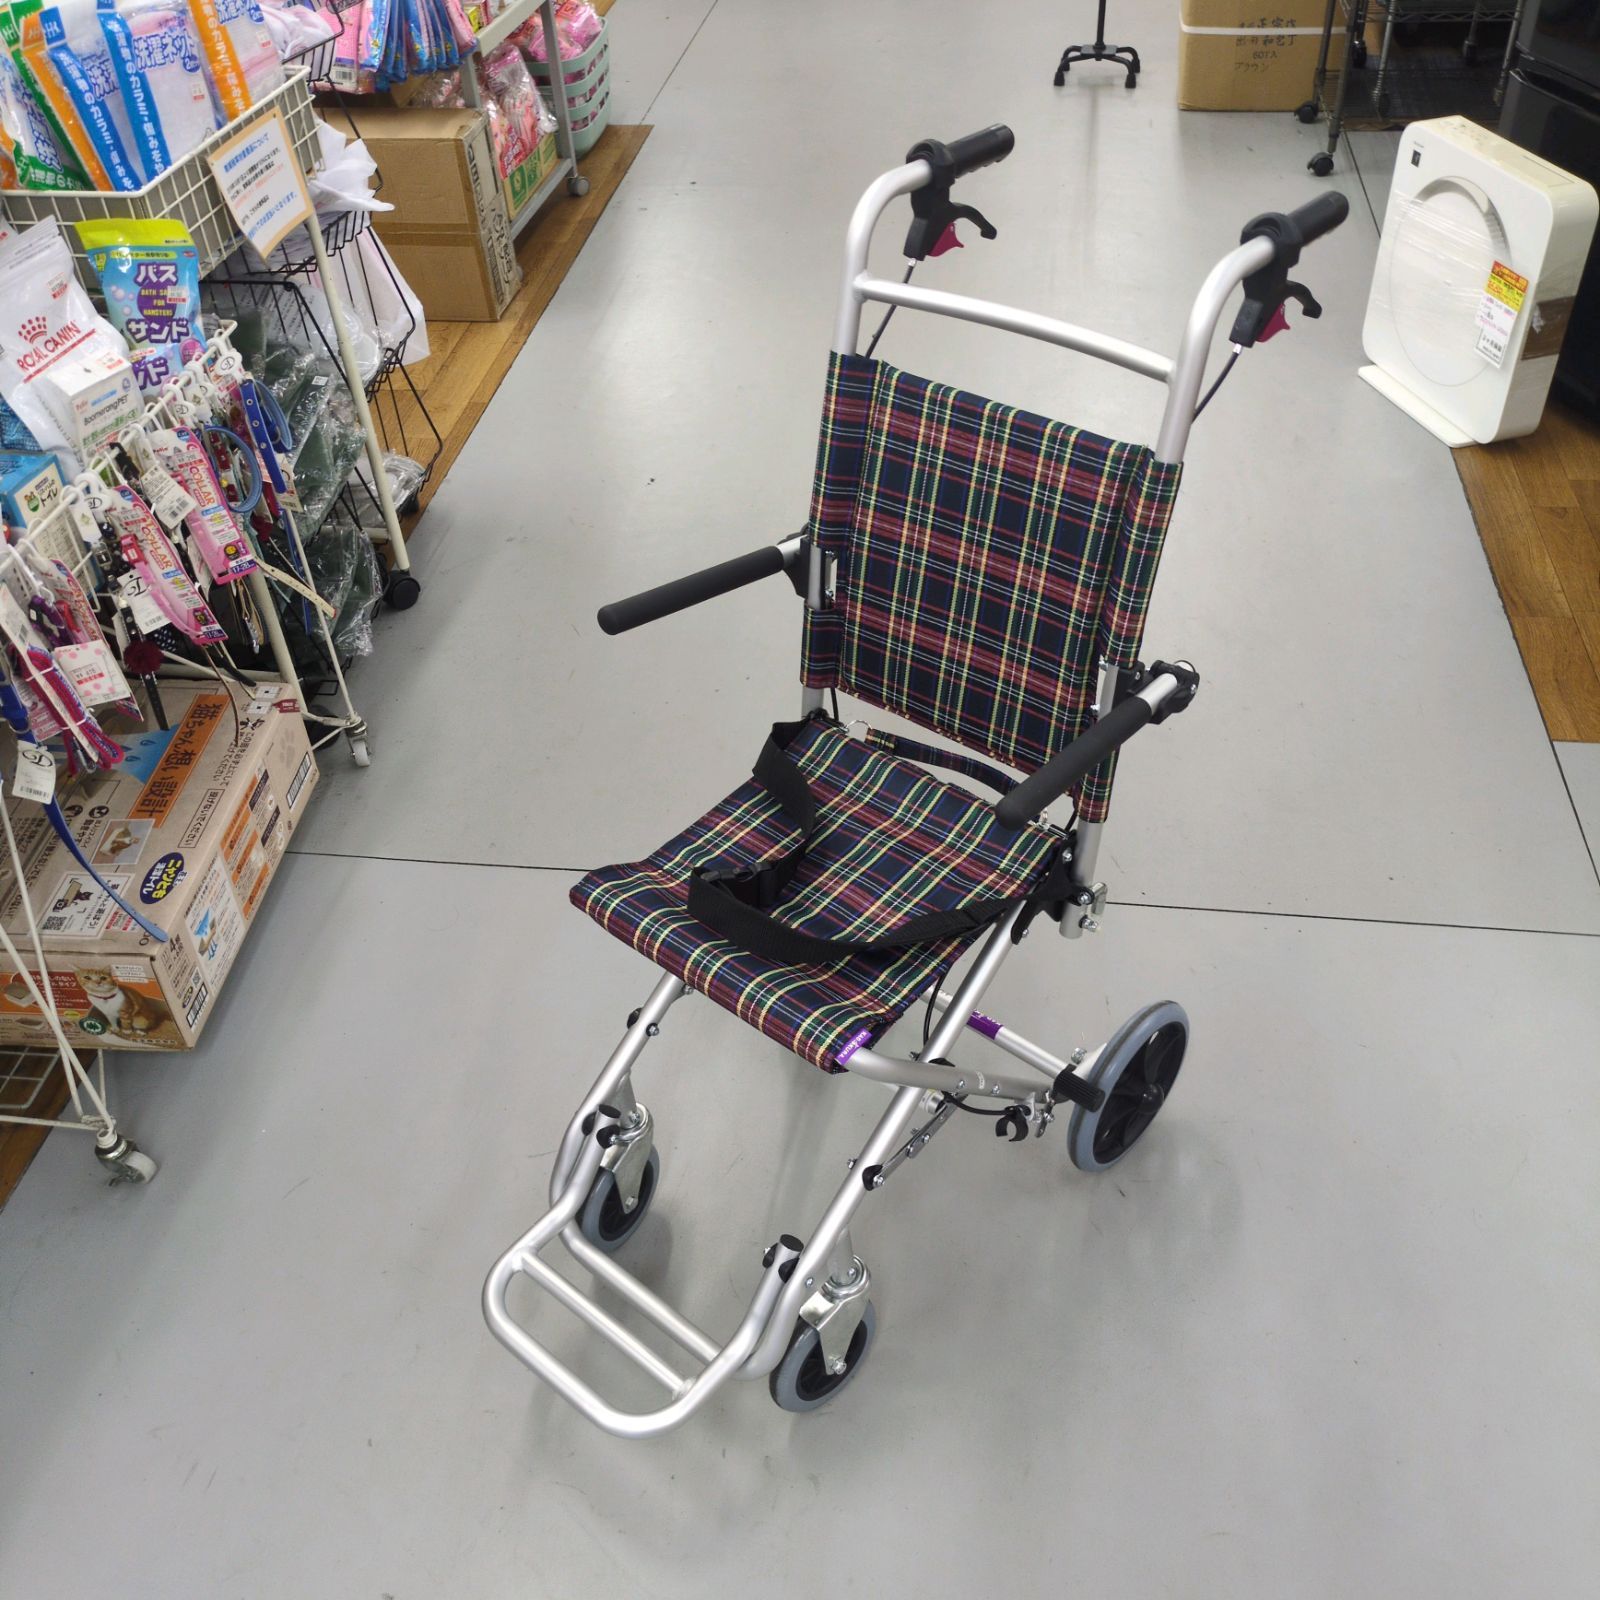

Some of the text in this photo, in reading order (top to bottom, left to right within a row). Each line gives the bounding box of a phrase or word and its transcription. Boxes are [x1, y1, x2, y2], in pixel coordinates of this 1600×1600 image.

[135, 264, 178, 285] バス
[44, 320, 81, 352] CANIN
[127, 319, 188, 342] サンド
[189, 465, 216, 506] COLLAR
[141, 526, 173, 569] COLLAR
[136, 702, 223, 816] 猫ちゃん想い設計
[151, 859, 183, 899] ニャンとも
